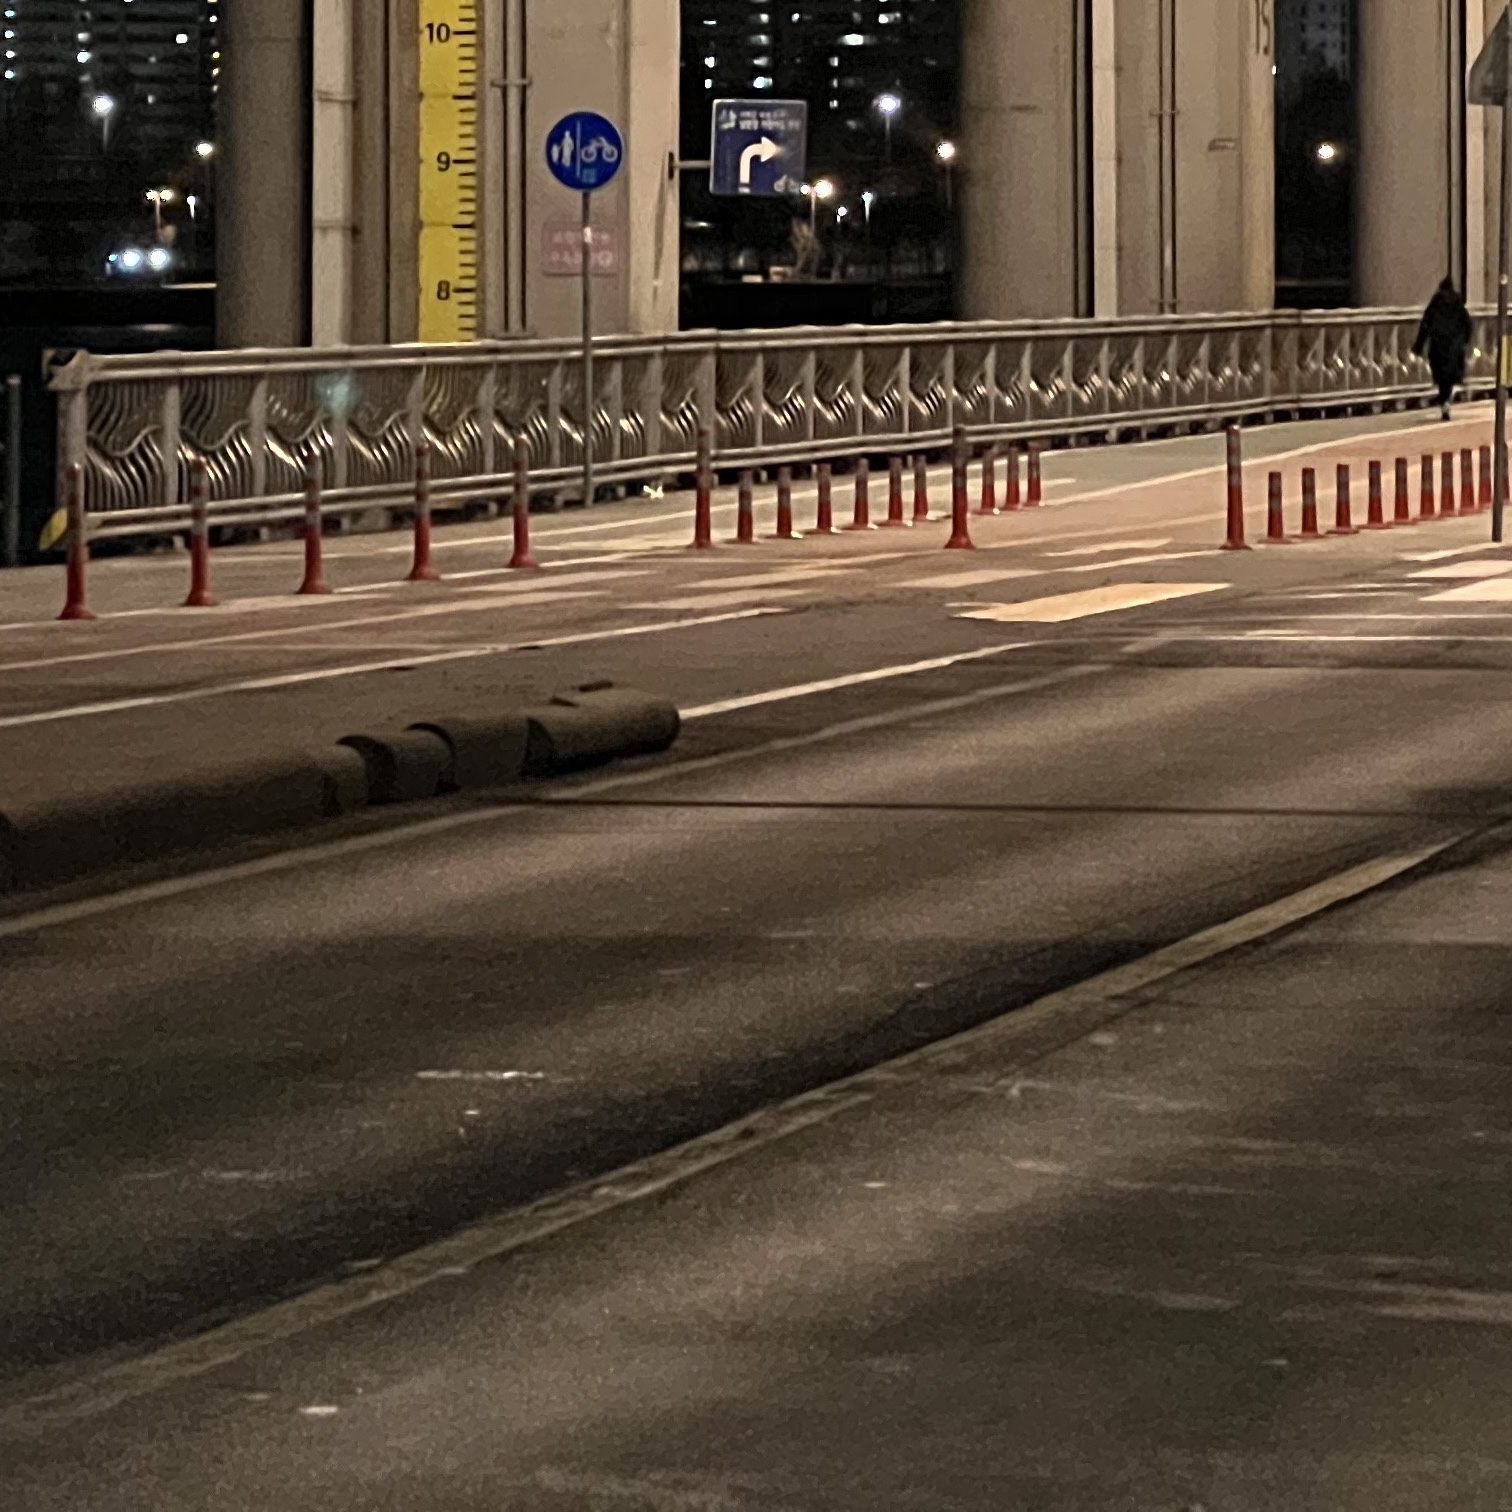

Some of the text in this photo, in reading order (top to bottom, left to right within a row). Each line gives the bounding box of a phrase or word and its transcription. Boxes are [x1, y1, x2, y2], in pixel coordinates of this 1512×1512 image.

[425, 22, 451, 44] 10
[436, 151, 451, 173] 9
[436, 279, 451, 301] 8
